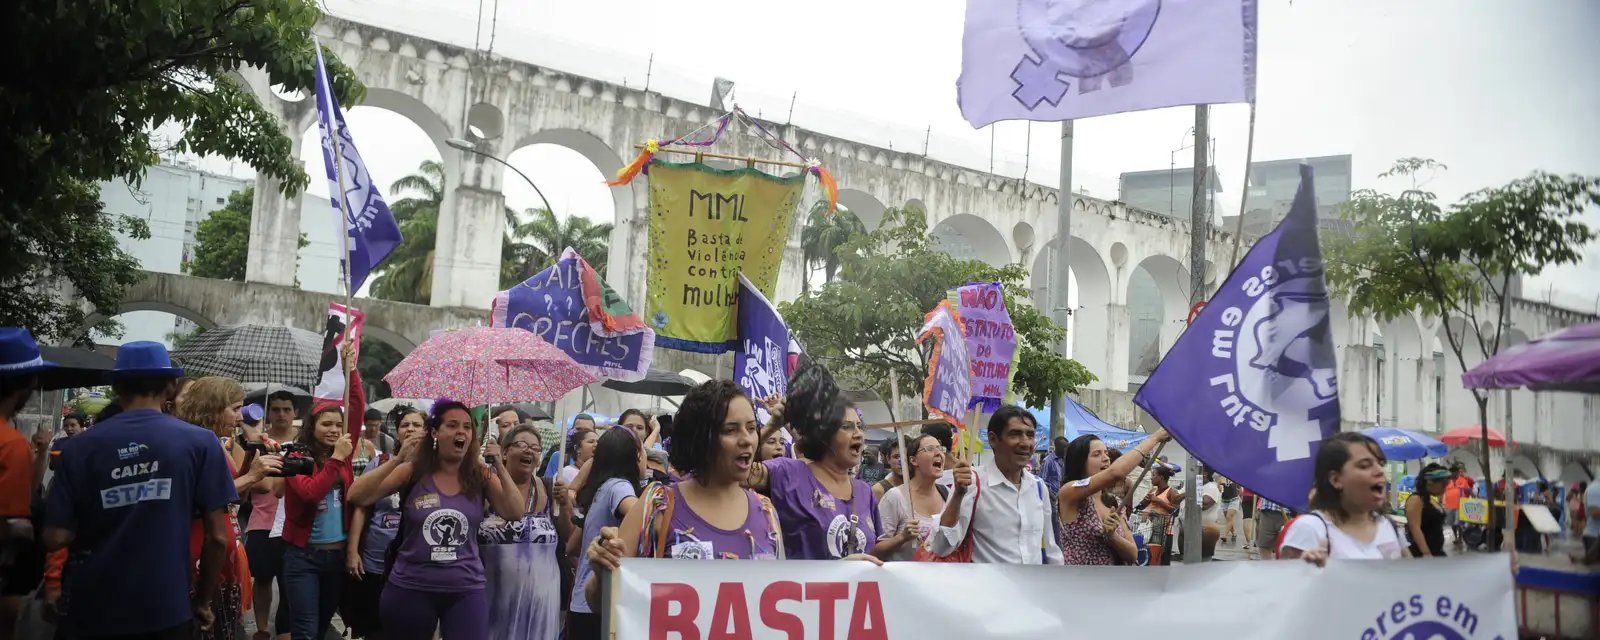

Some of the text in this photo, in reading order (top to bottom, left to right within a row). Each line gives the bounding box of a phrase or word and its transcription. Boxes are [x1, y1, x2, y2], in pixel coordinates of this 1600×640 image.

[689, 189, 748, 222] MML
[687, 229, 731, 247] Basta
[960, 285, 998, 310] NÃO
[976, 343, 992, 359] DO
[603, 360, 623, 369] MML
[111, 460, 159, 480] CAIXA
[104, 480, 170, 505] STAFF
[648, 580, 889, 640] BASTA
[1435, 595, 1479, 635] em
